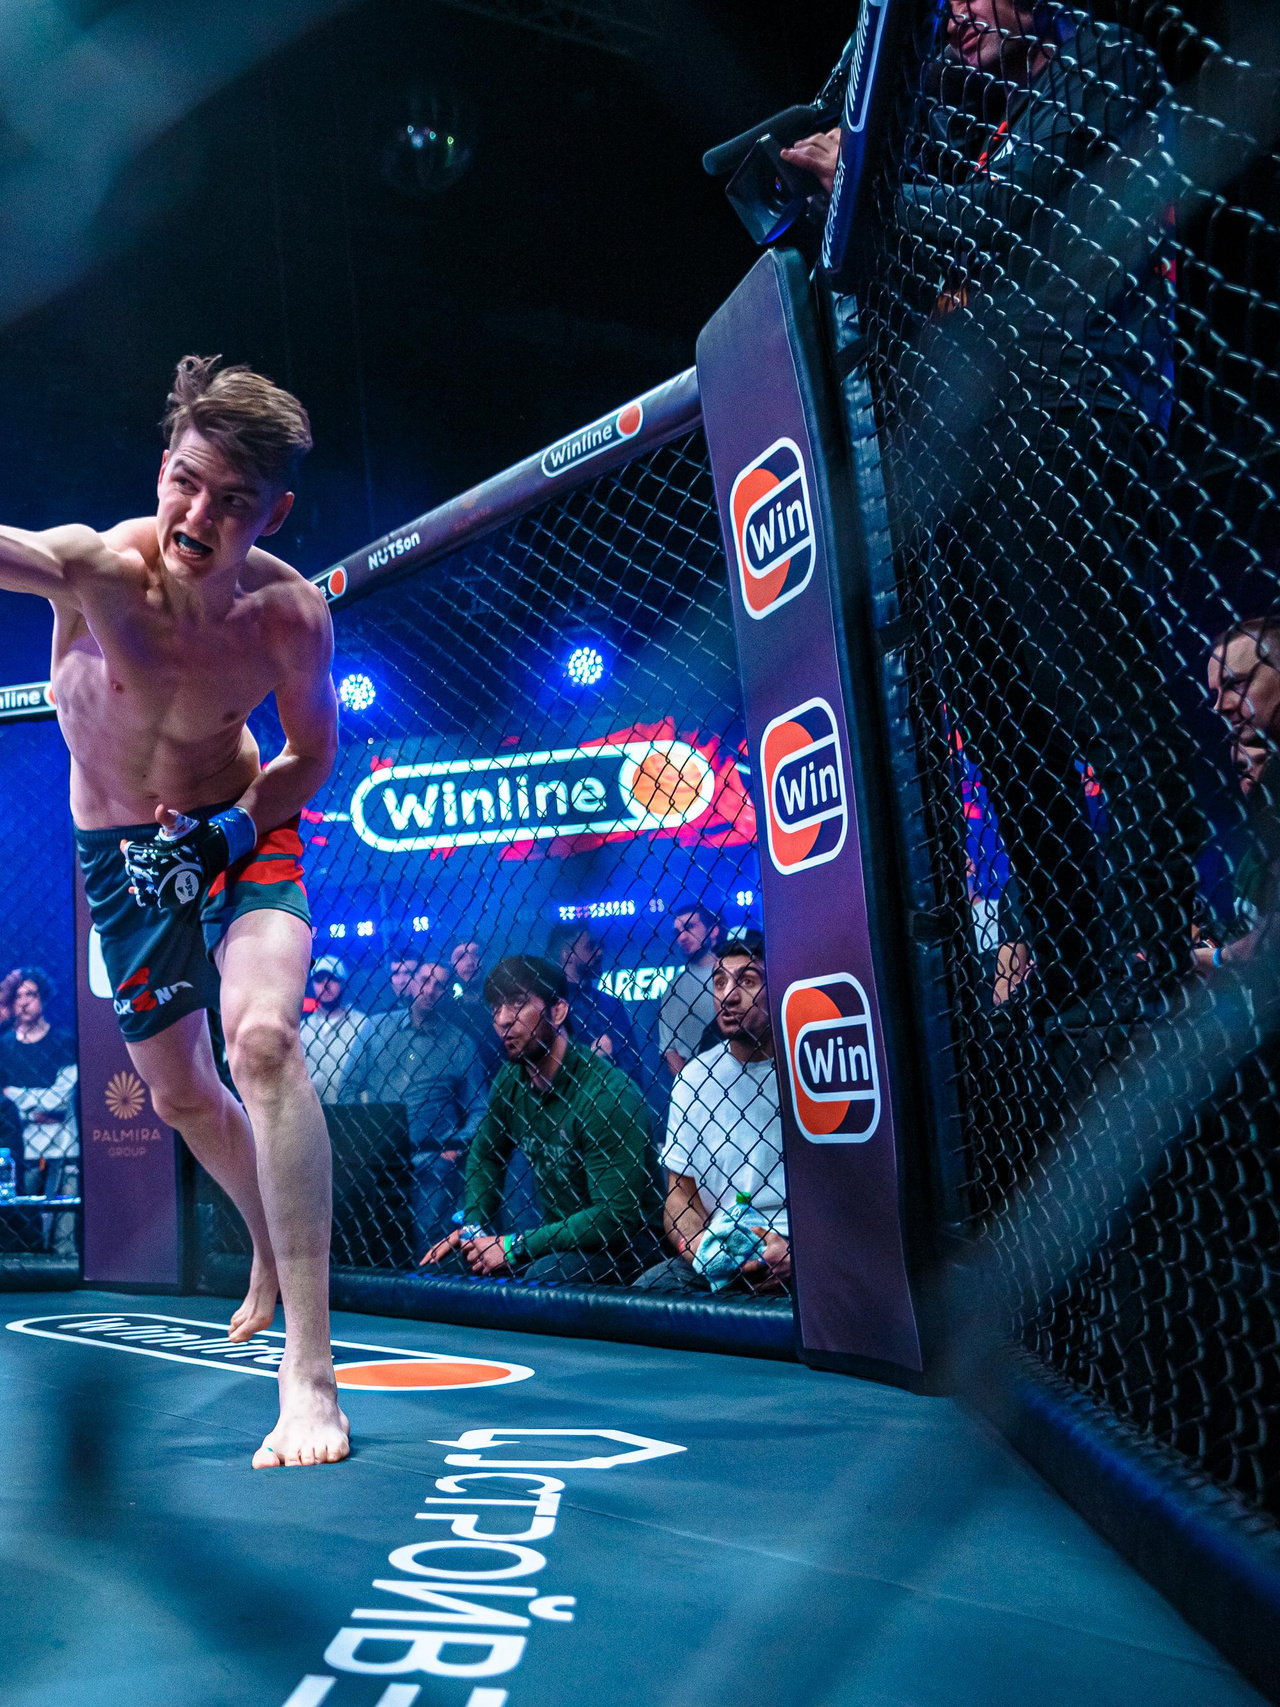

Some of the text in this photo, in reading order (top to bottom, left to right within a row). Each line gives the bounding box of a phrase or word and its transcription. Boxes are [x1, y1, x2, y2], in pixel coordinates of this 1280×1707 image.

[550, 424, 613, 468] Winline
[367, 532, 420, 571] NUTSon
[749, 499, 806, 561] Win
[381, 774, 608, 831] Winline
[780, 761, 838, 816] Win
[803, 1036, 870, 1084] Win
[92, 1128, 161, 1142] PALMIRA
[280, 1472, 576, 1707] СТРОЙВ
